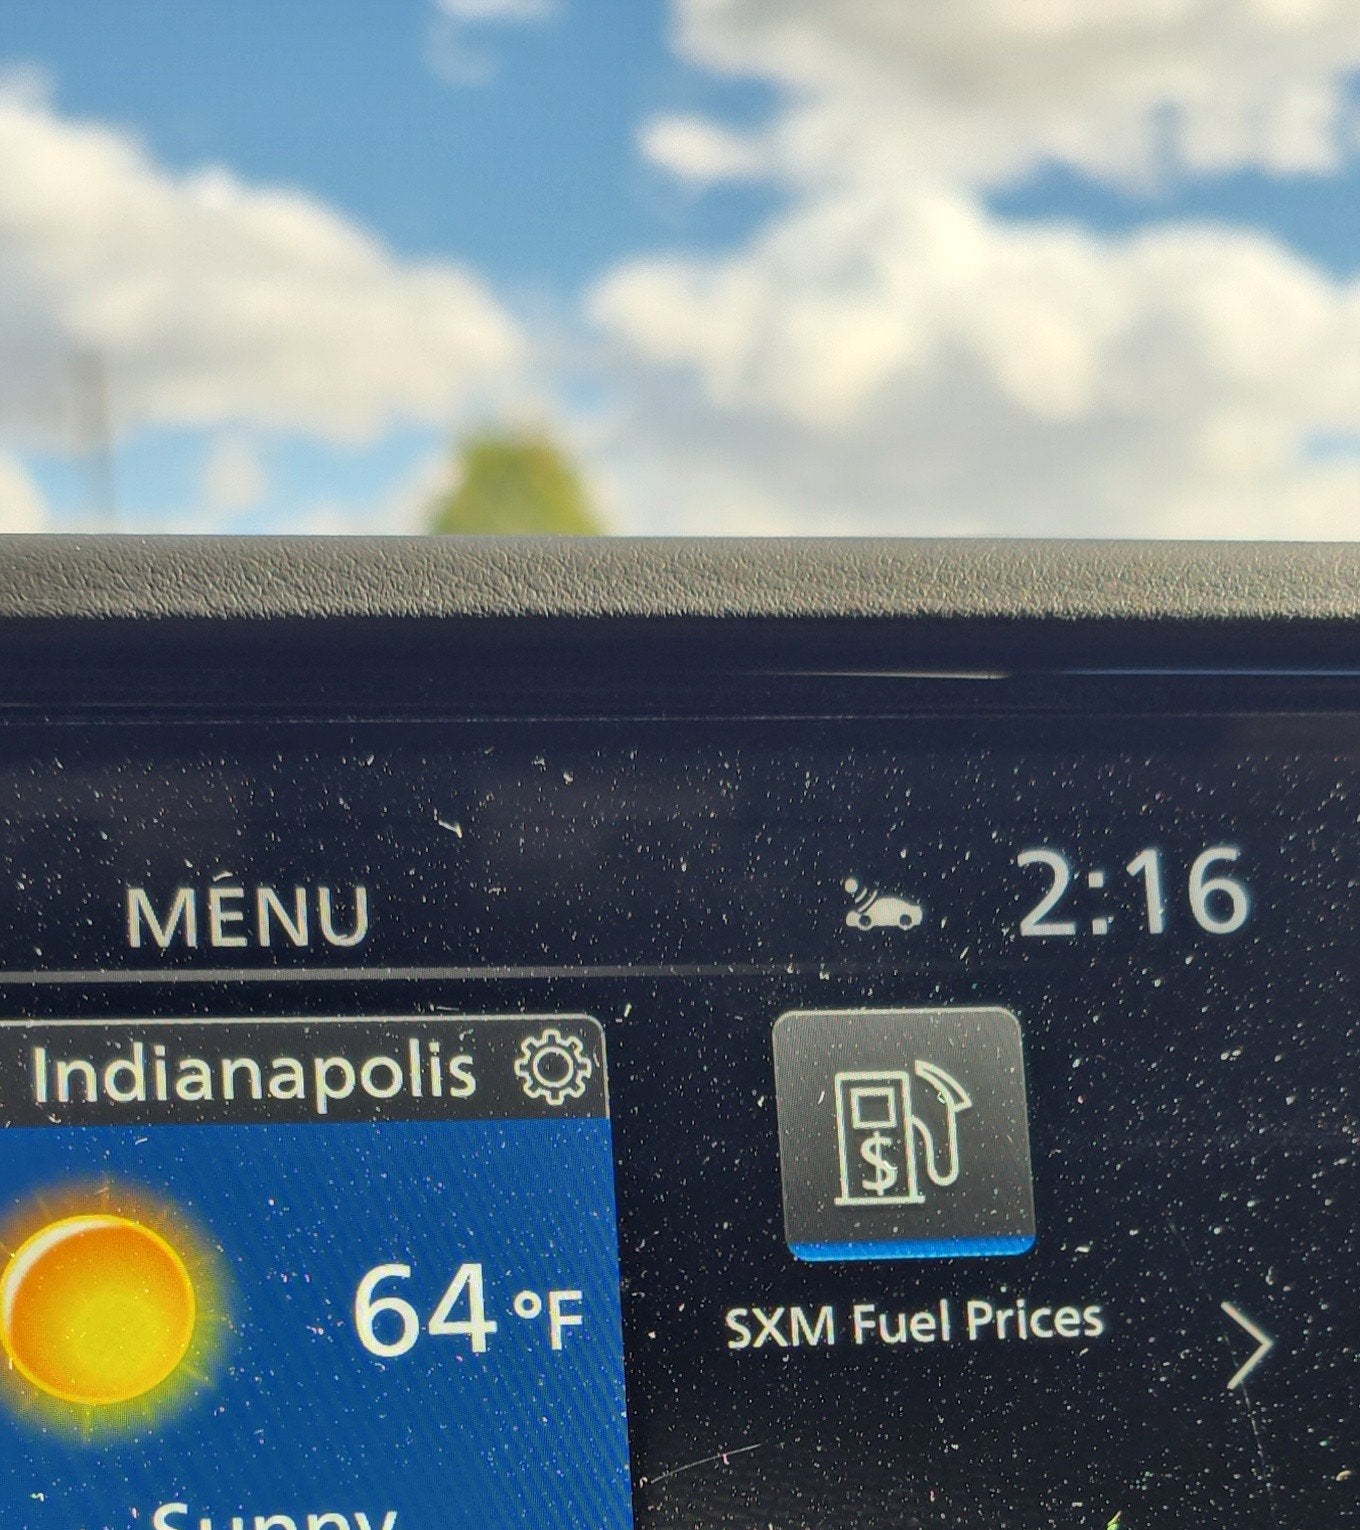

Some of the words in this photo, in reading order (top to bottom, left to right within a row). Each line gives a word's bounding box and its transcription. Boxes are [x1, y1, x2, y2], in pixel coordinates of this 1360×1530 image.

[128, 887, 368, 948] MENU
[1018, 847, 1249, 936] 2:16
[35, 1038, 476, 1114] Indianapolis
[726, 1306, 834, 1350] SXM
[854, 1299, 950, 1344] Fuel
[967, 1299, 1104, 1340] Prices
